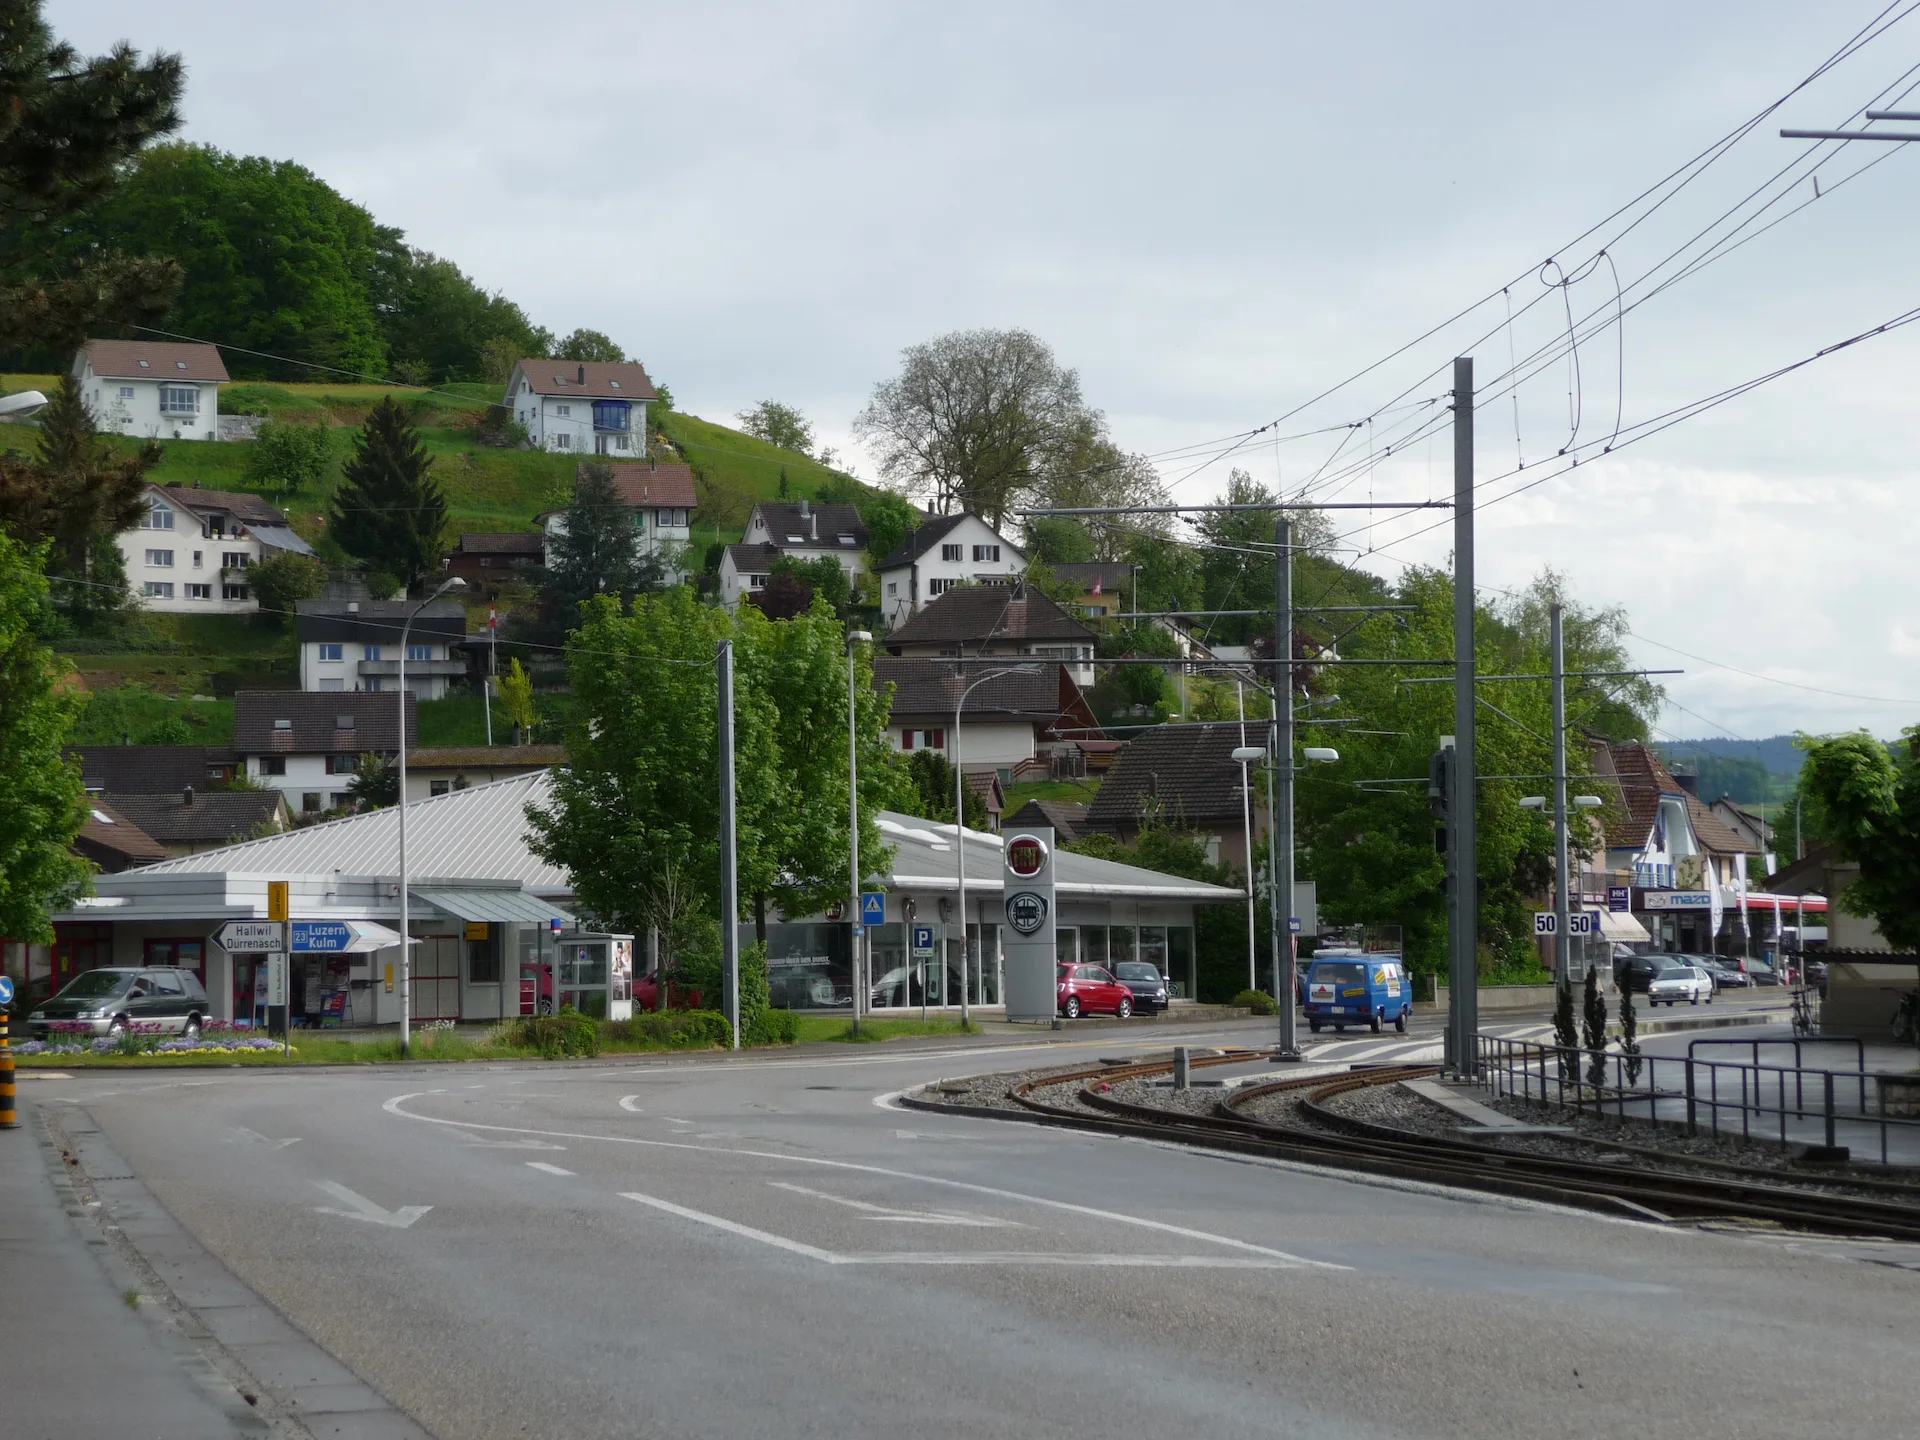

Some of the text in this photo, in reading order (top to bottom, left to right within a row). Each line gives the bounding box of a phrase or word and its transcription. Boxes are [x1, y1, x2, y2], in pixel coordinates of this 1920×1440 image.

[1670, 895, 1711, 904] mazd
[1536, 915, 1555, 932] 50
[1570, 916, 1589, 932] 50
[236, 925, 271, 936] Hallwil
[309, 925, 345, 935] Luzern
[294, 932, 306, 942] 23
[918, 930, 929, 946] P
[227, 938, 280, 949] Dürrenäsch
[309, 938, 337, 948] Kulm
